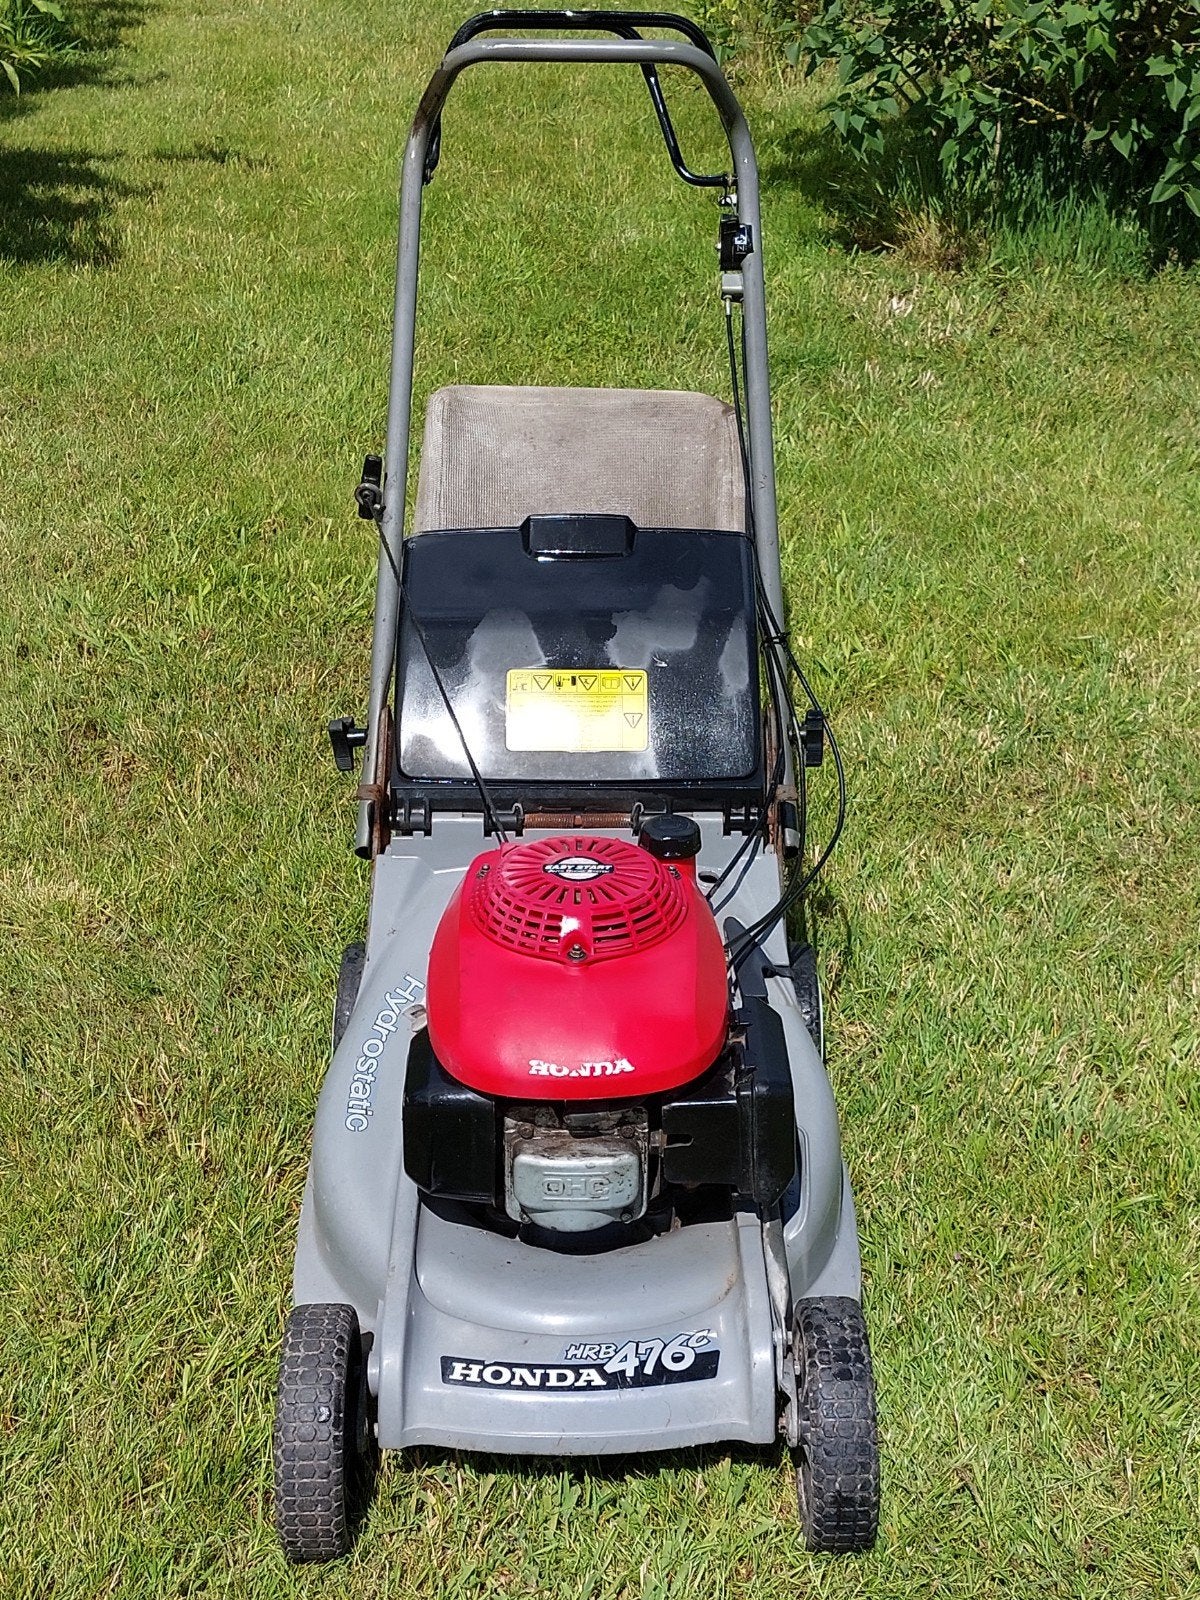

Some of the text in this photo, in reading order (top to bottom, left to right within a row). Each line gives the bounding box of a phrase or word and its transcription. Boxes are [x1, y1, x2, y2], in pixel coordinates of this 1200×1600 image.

[345, 973, 425, 1133] Hydrostatic
[542, 1177, 611, 1197] OHC
[449, 1361, 607, 1388] HONDA
